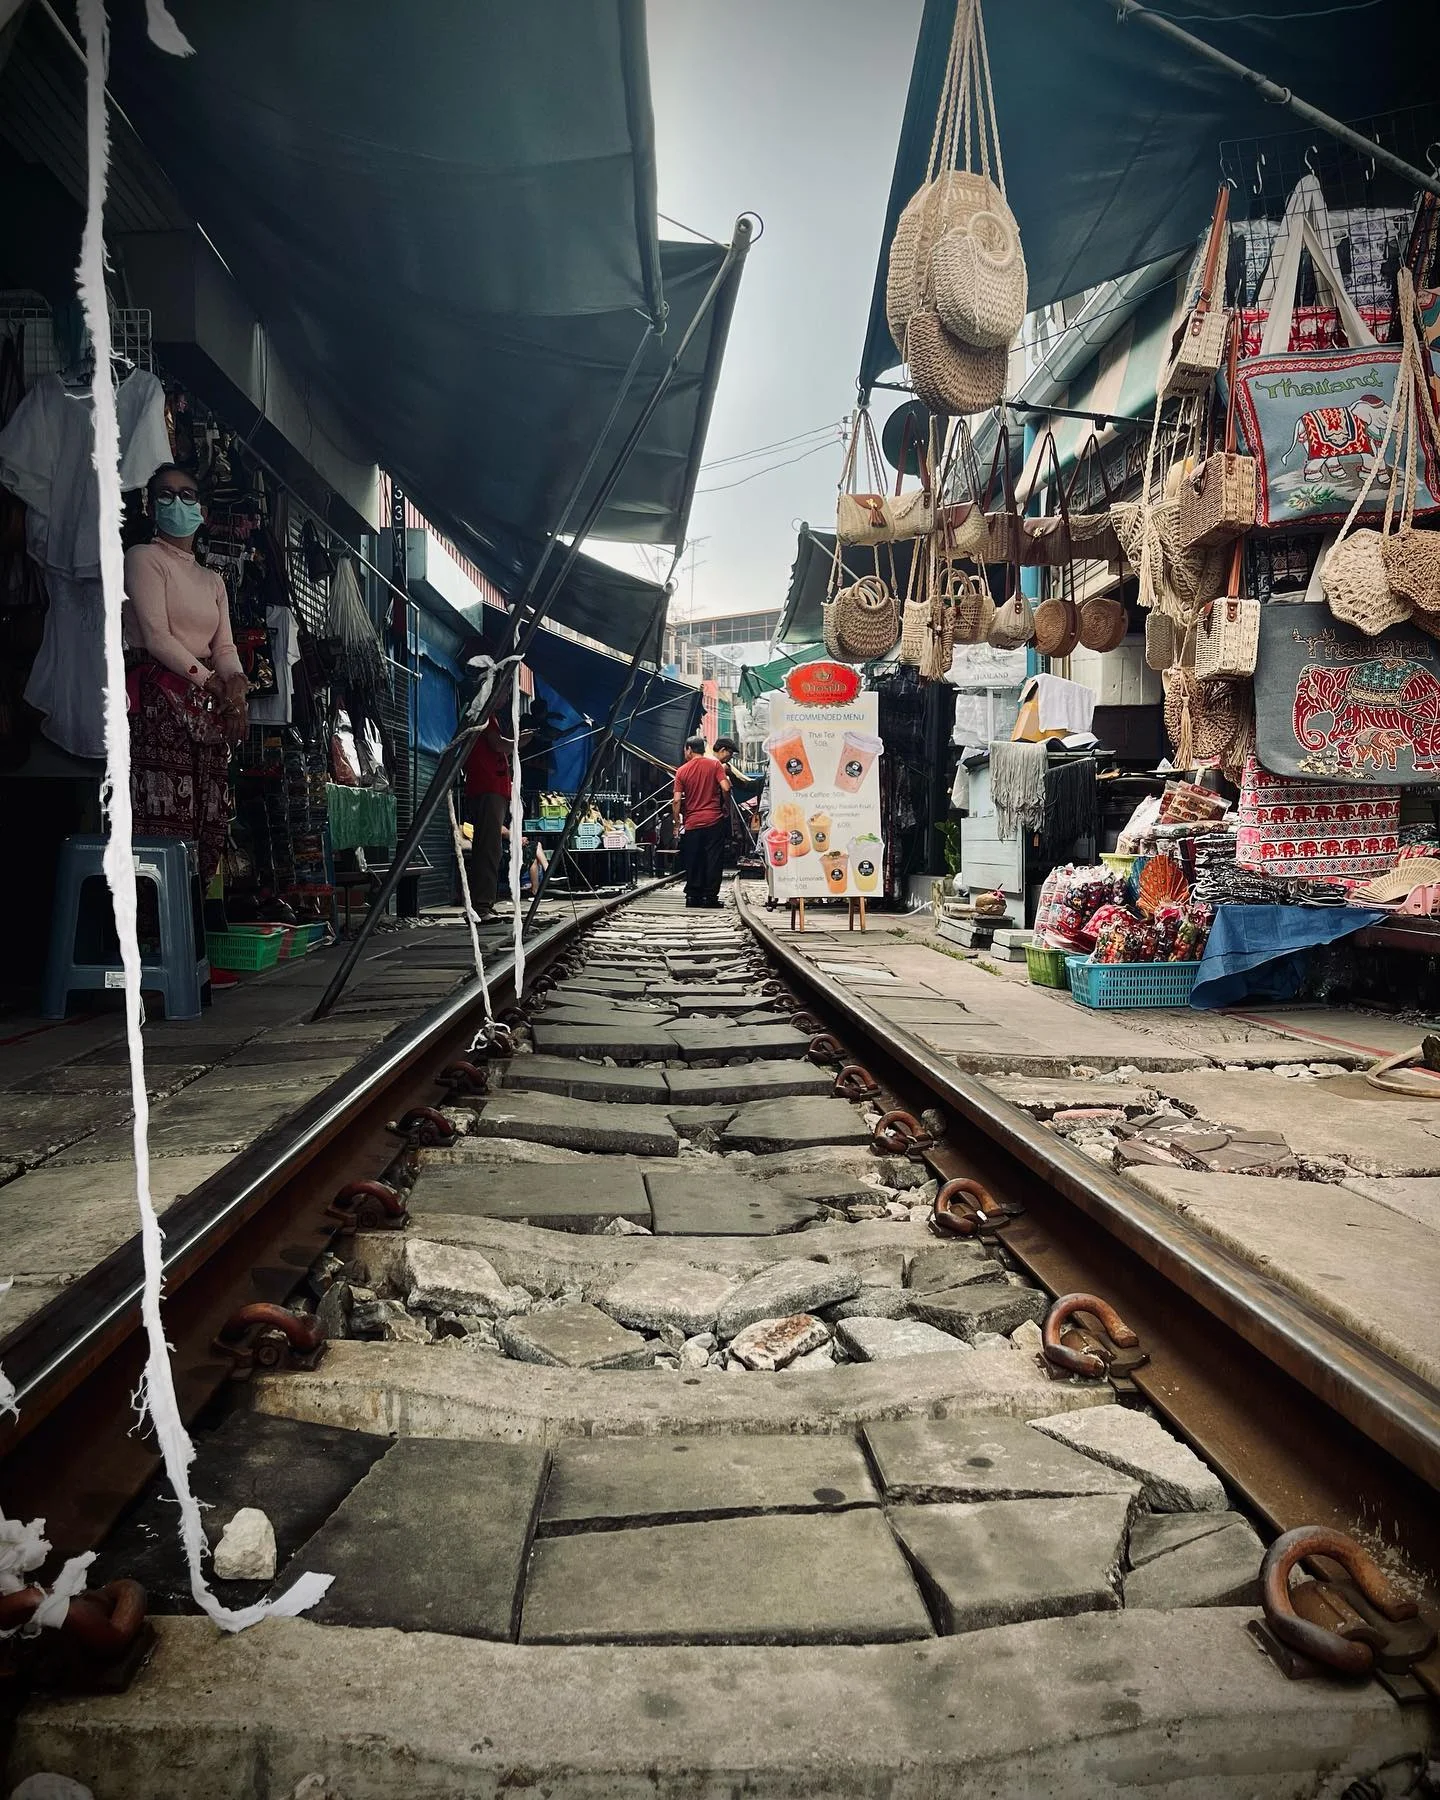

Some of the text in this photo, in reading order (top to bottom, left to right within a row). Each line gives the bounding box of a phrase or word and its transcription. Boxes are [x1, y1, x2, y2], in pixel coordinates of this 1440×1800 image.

[1255, 368, 1383, 399] Thailand
[1291, 627, 1434, 661] Thailand
[974, 672, 1009, 680] THAILAND
[786, 713, 843, 721] RECOMMENDED
[808, 731, 836, 739] Thai Tea
